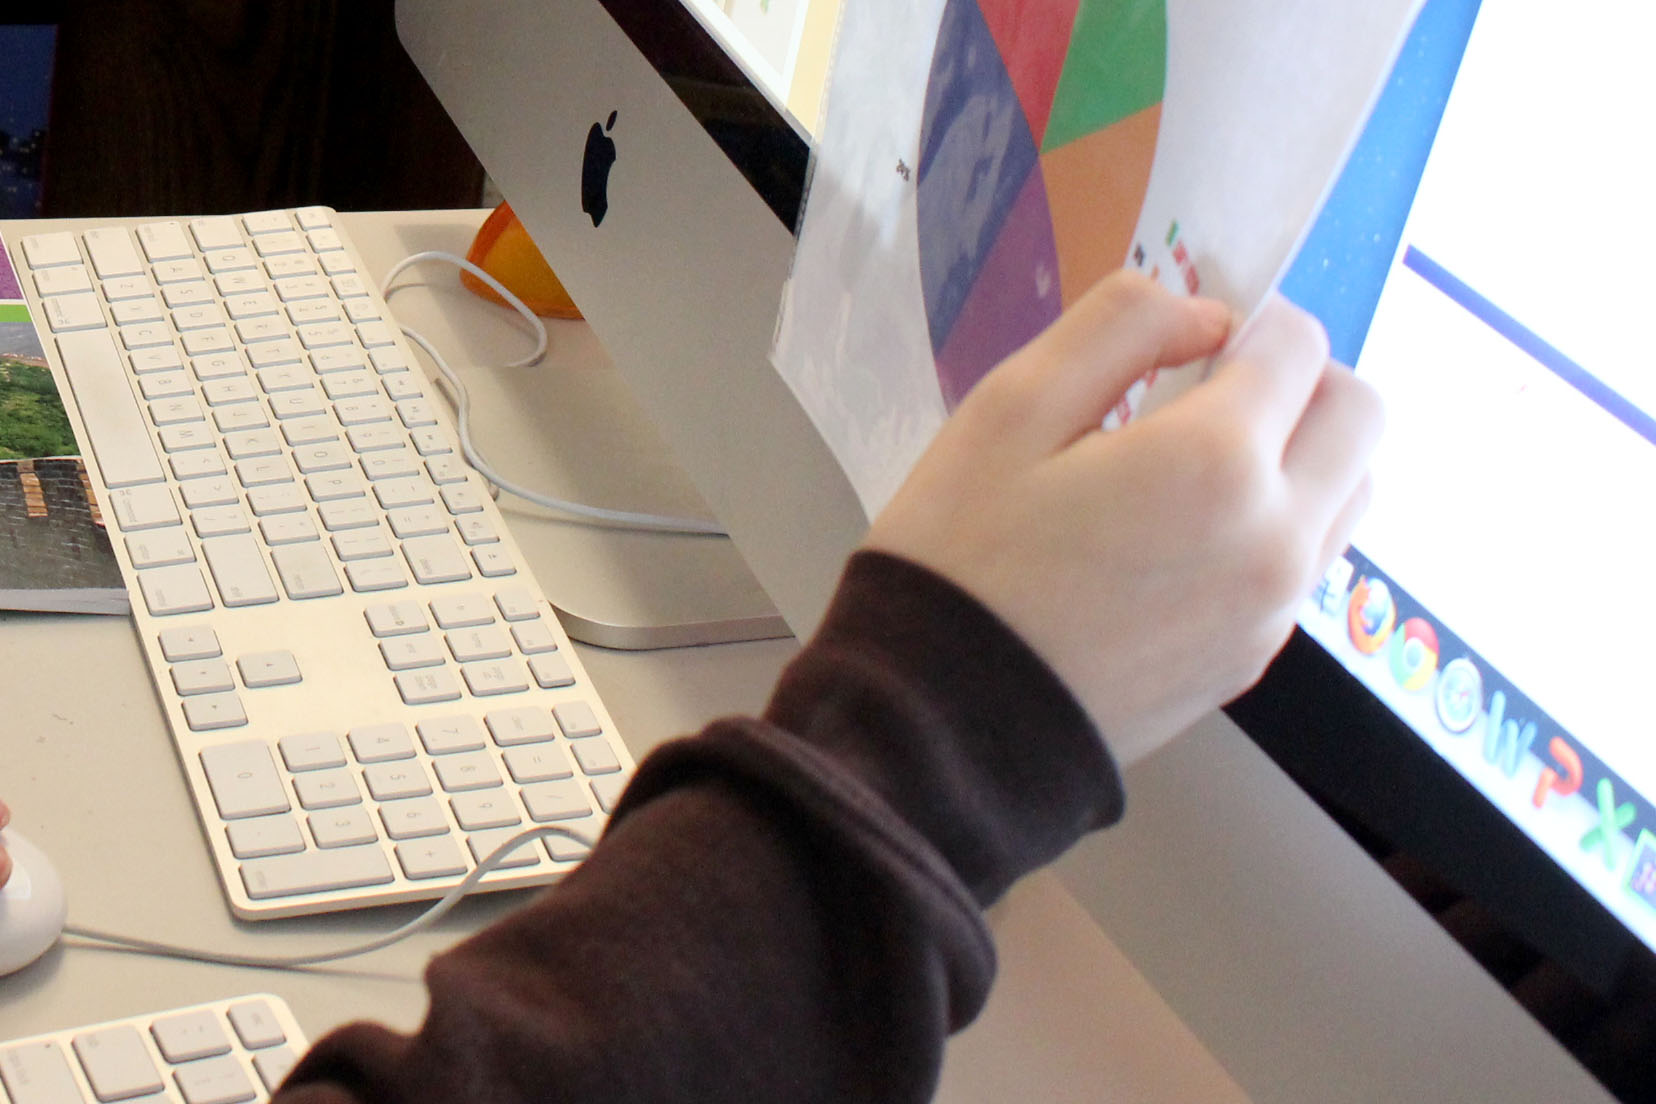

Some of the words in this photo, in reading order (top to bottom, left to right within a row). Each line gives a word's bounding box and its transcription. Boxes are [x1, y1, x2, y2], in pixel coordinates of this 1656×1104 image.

[1483, 690, 1538, 778] W
[1531, 736, 1584, 809] P
[1579, 777, 1637, 871] X
